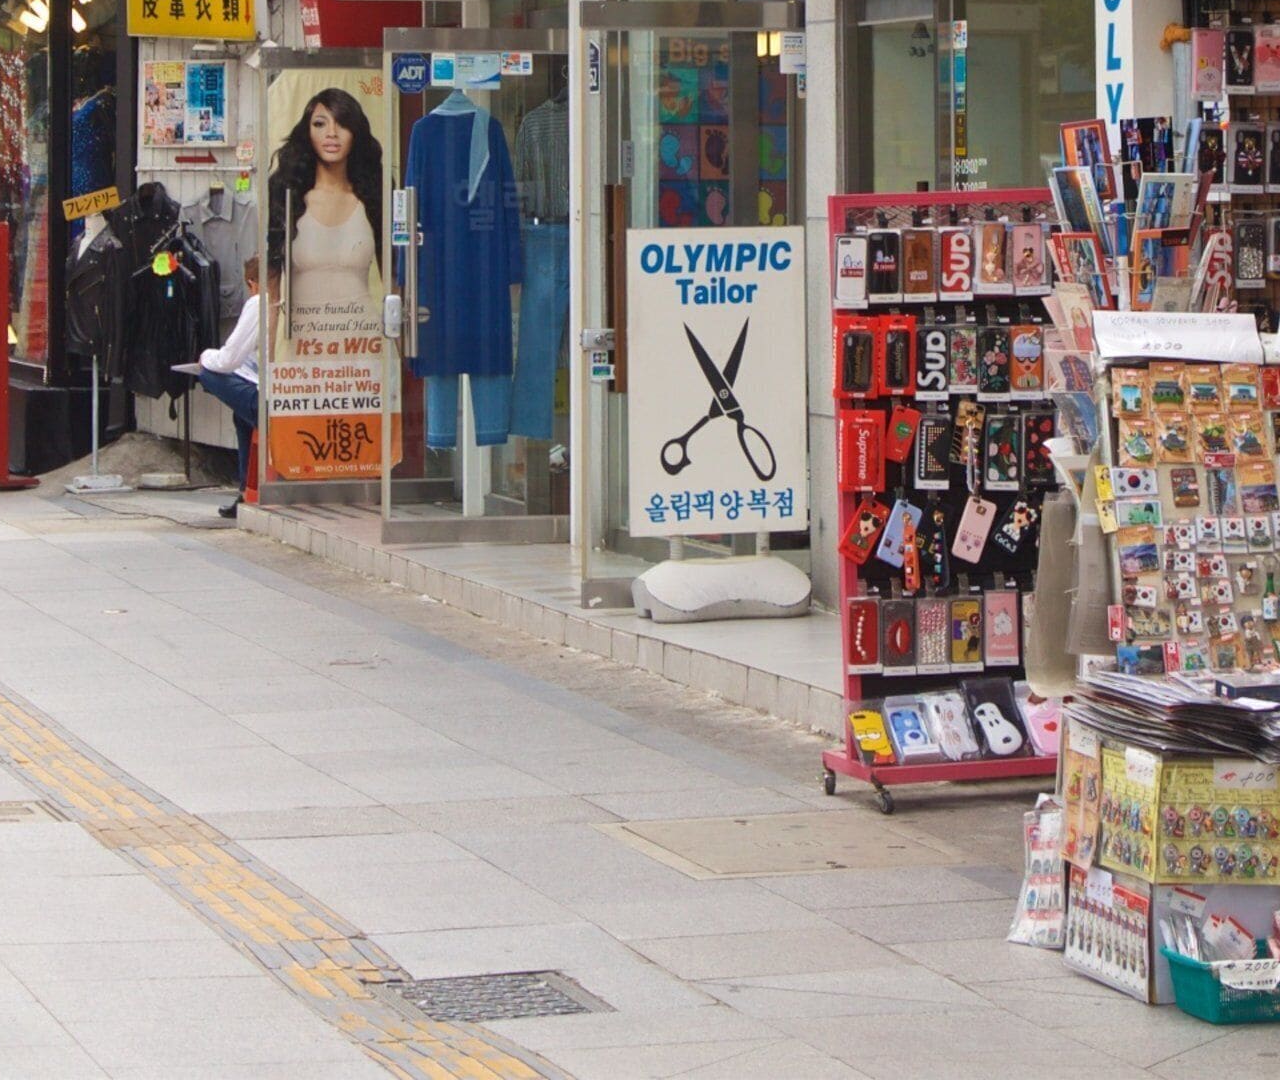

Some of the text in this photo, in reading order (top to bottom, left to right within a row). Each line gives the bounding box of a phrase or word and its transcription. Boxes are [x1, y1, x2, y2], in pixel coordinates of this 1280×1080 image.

[398, 65, 426, 81] ADT
[65, 191, 118, 216] フレンドリー
[639, 241, 793, 274] OLYMPIC
[942, 232, 970, 291] Sup
[675, 278, 758, 306] Tailor
[296, 303, 365, 316] more bundles
[307, 319, 353, 333] Natural
[295, 336, 382, 356] It's a WIG
[917, 330, 946, 391] Sup
[272, 366, 371, 380] 100% Brazilian
[272, 380, 382, 396] Human Hair Wig
[273, 396, 382, 411] PART LACE WIG
[856, 428, 870, 481] Supreme
